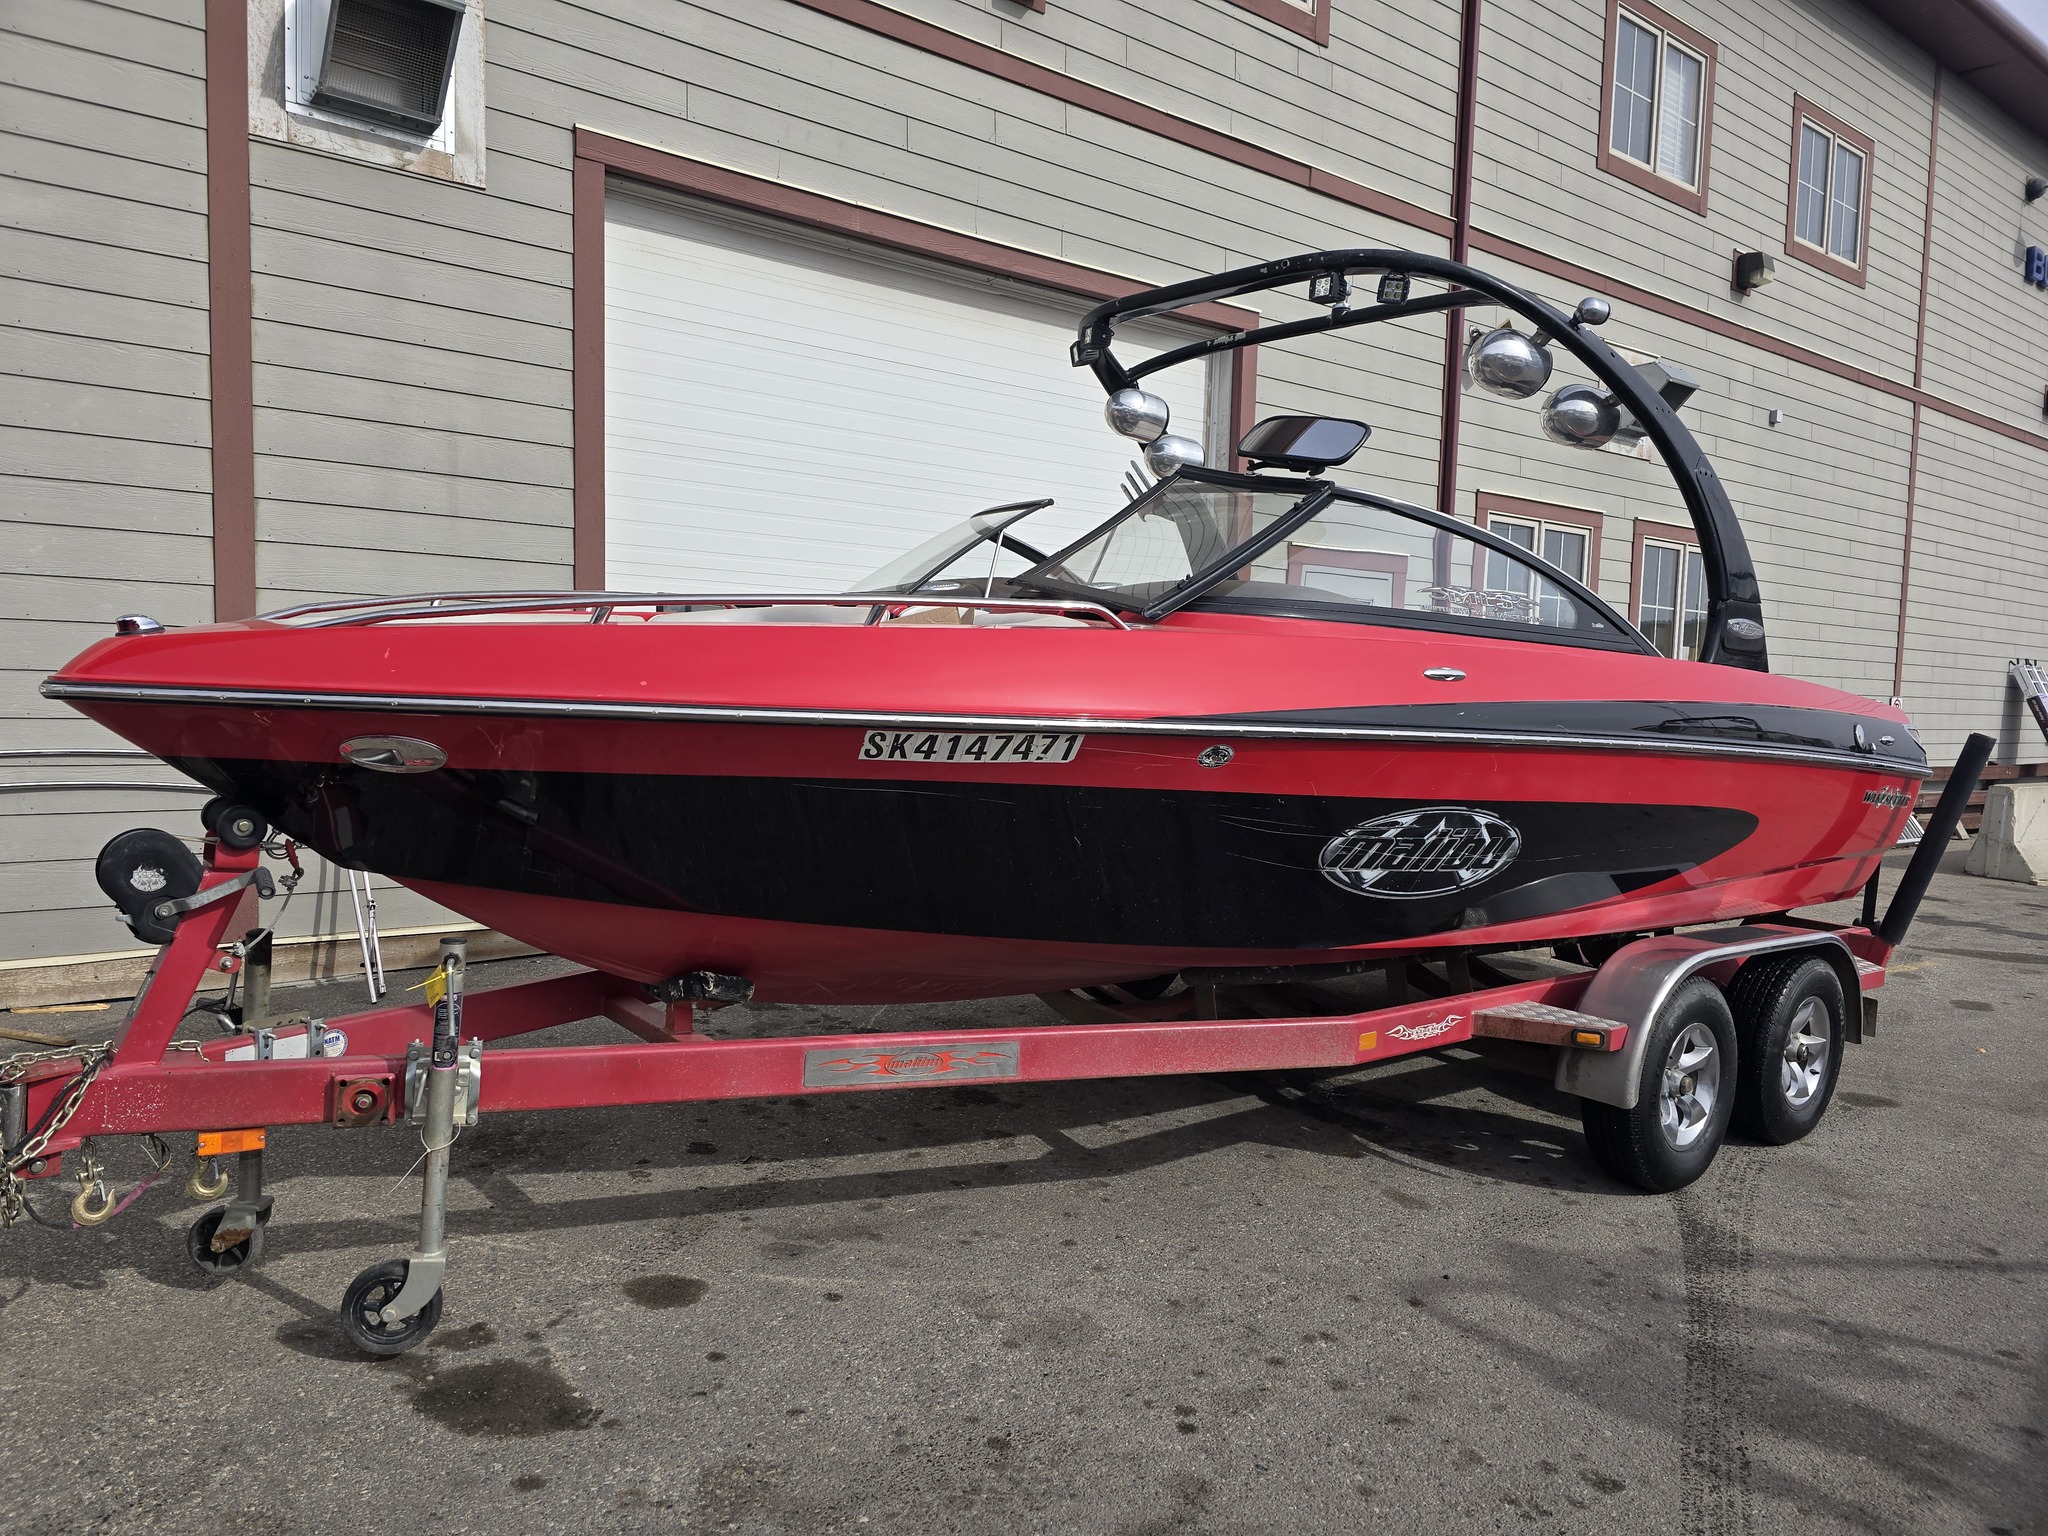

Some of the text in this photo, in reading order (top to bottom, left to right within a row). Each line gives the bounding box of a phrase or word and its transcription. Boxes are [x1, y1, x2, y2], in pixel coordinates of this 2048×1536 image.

[863, 731, 1079, 761] SK4147471
[1323, 827, 1517, 872] malibu
[886, 1056, 940, 1069] malibu
